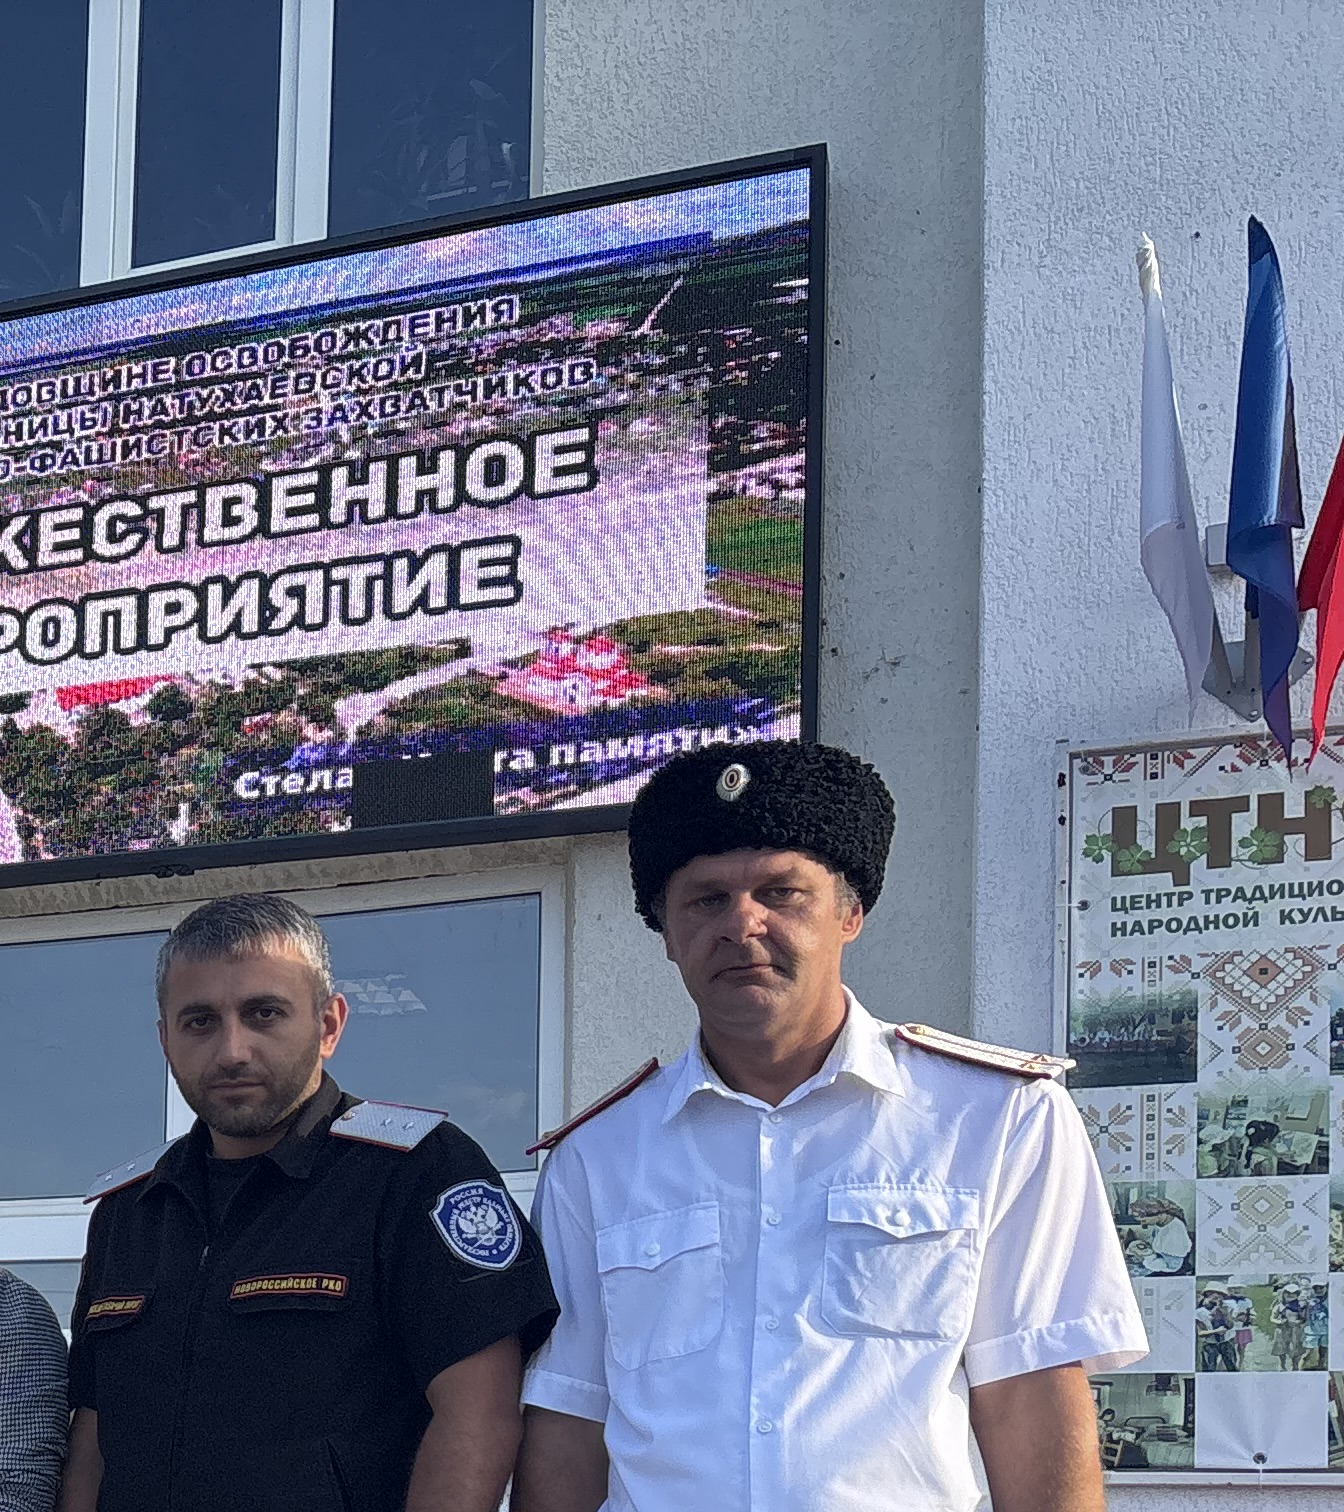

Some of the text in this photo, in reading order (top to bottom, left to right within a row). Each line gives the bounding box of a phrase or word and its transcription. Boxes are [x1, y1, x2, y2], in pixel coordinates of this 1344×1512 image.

[184, 294, 521, 380] ОСВОБОЖДЕНИЯ
[120, 344, 426, 428] НАТУХАЕВСКОЙ
[302, 357, 597, 433] ЗАХВАТЧИКОВ
[1110, 890, 1194, 914] ЦЕНТР
[1110, 906, 1260, 938] НАРОДНОЙ
